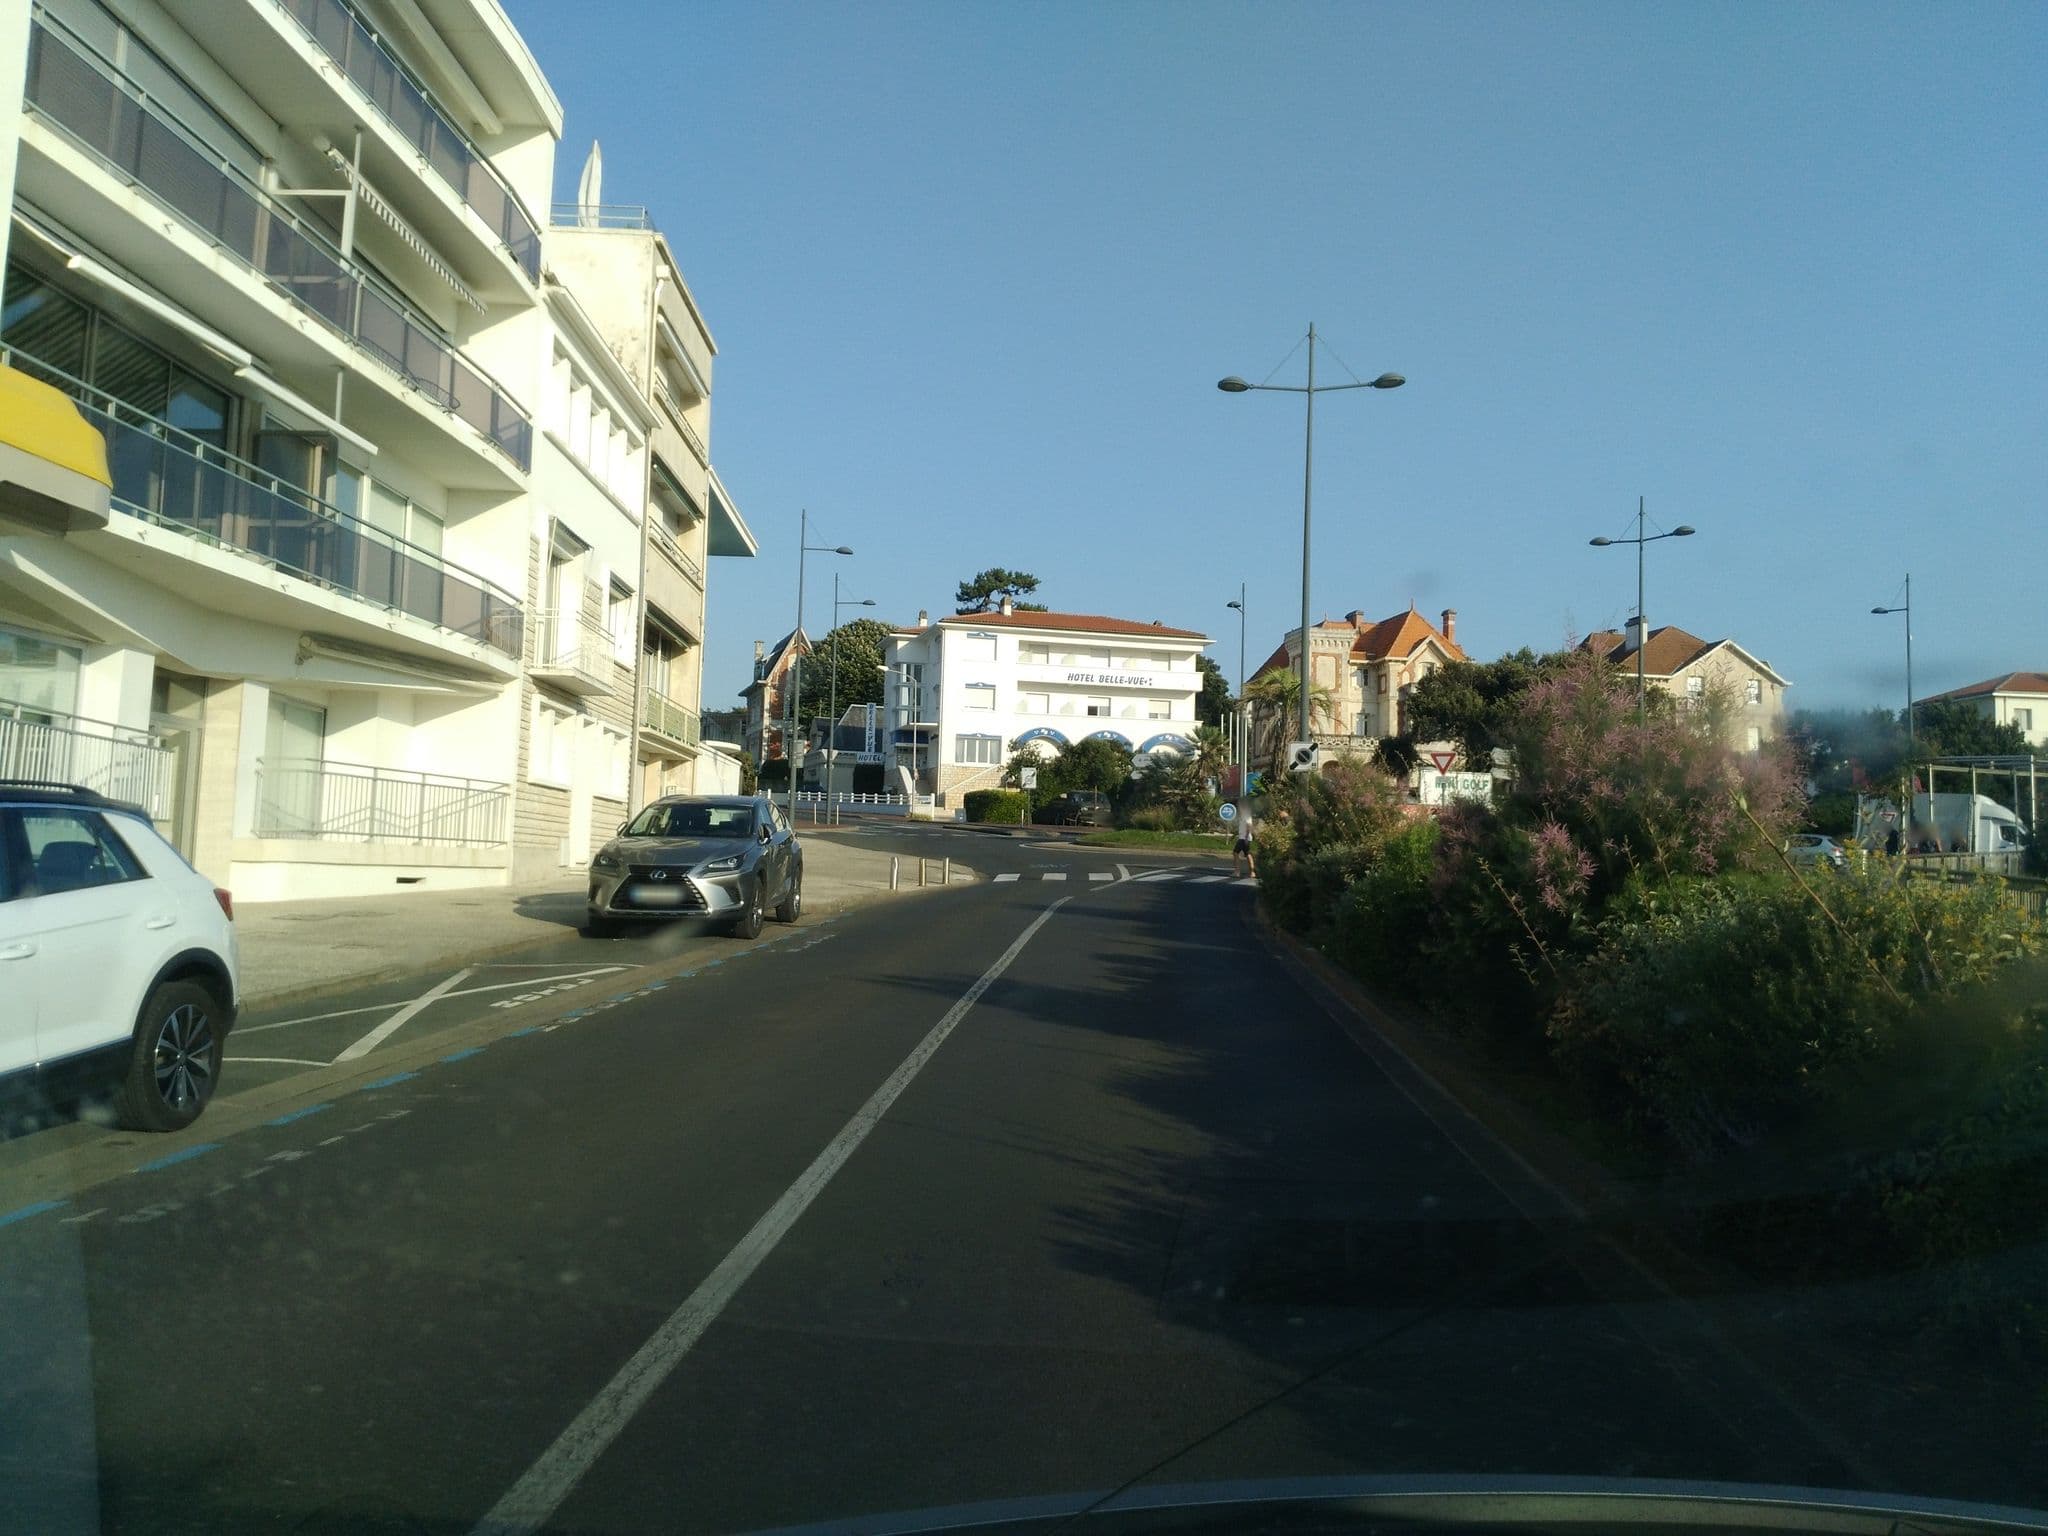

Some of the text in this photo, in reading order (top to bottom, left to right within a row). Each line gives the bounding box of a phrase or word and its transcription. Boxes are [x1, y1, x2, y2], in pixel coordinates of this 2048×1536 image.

[1067, 672, 1145, 686] HOTEL BELLE-VUE
[858, 754, 882, 762] HOTEL
[1435, 777, 1489, 789] MNI GOLF
